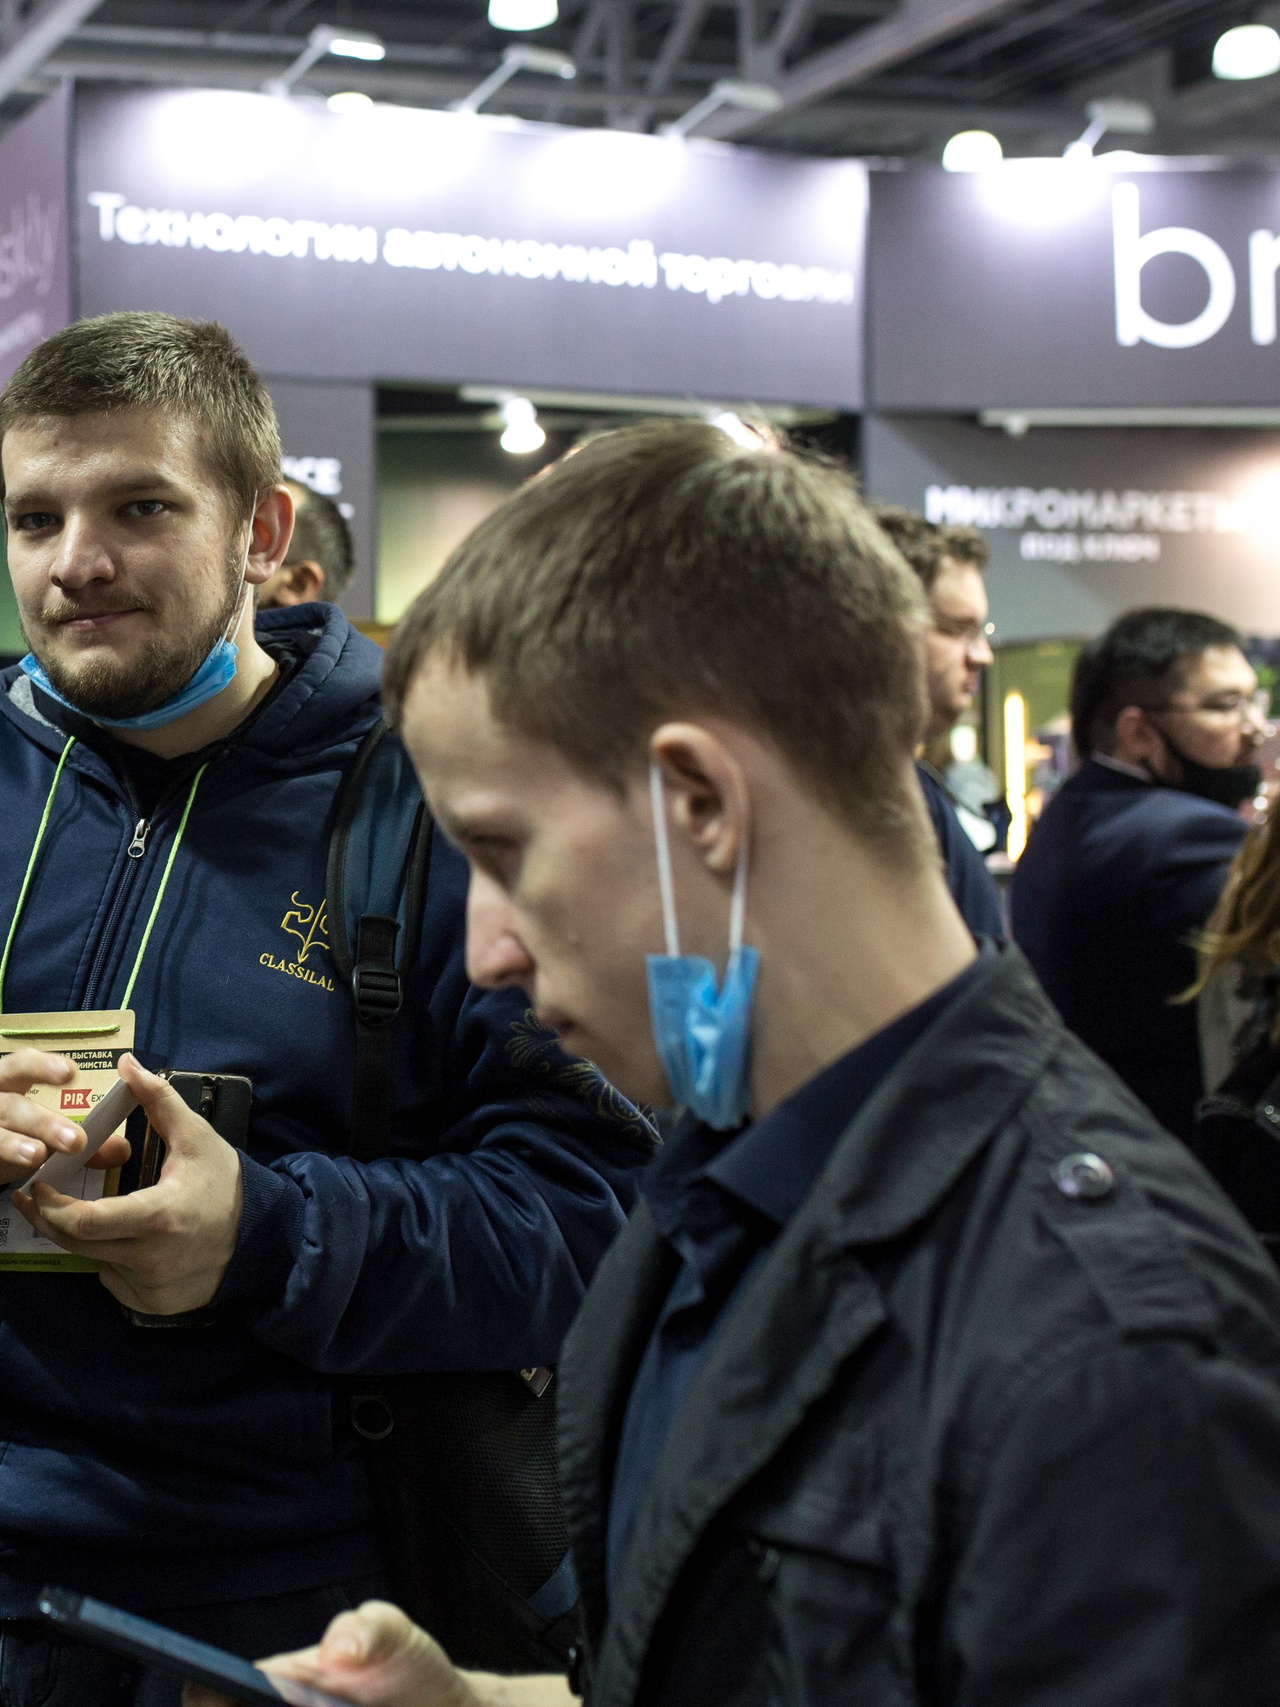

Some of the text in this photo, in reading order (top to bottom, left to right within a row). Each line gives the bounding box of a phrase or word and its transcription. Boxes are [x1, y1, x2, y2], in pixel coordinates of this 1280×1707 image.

[87, 191, 854, 304] Технологии автономной торговли
[71, 1050, 113, 1060] ВЫСТАВКА
[77, 1060, 113, 1069] ИИМСТВА
[63, 1092, 85, 1106] PIR
